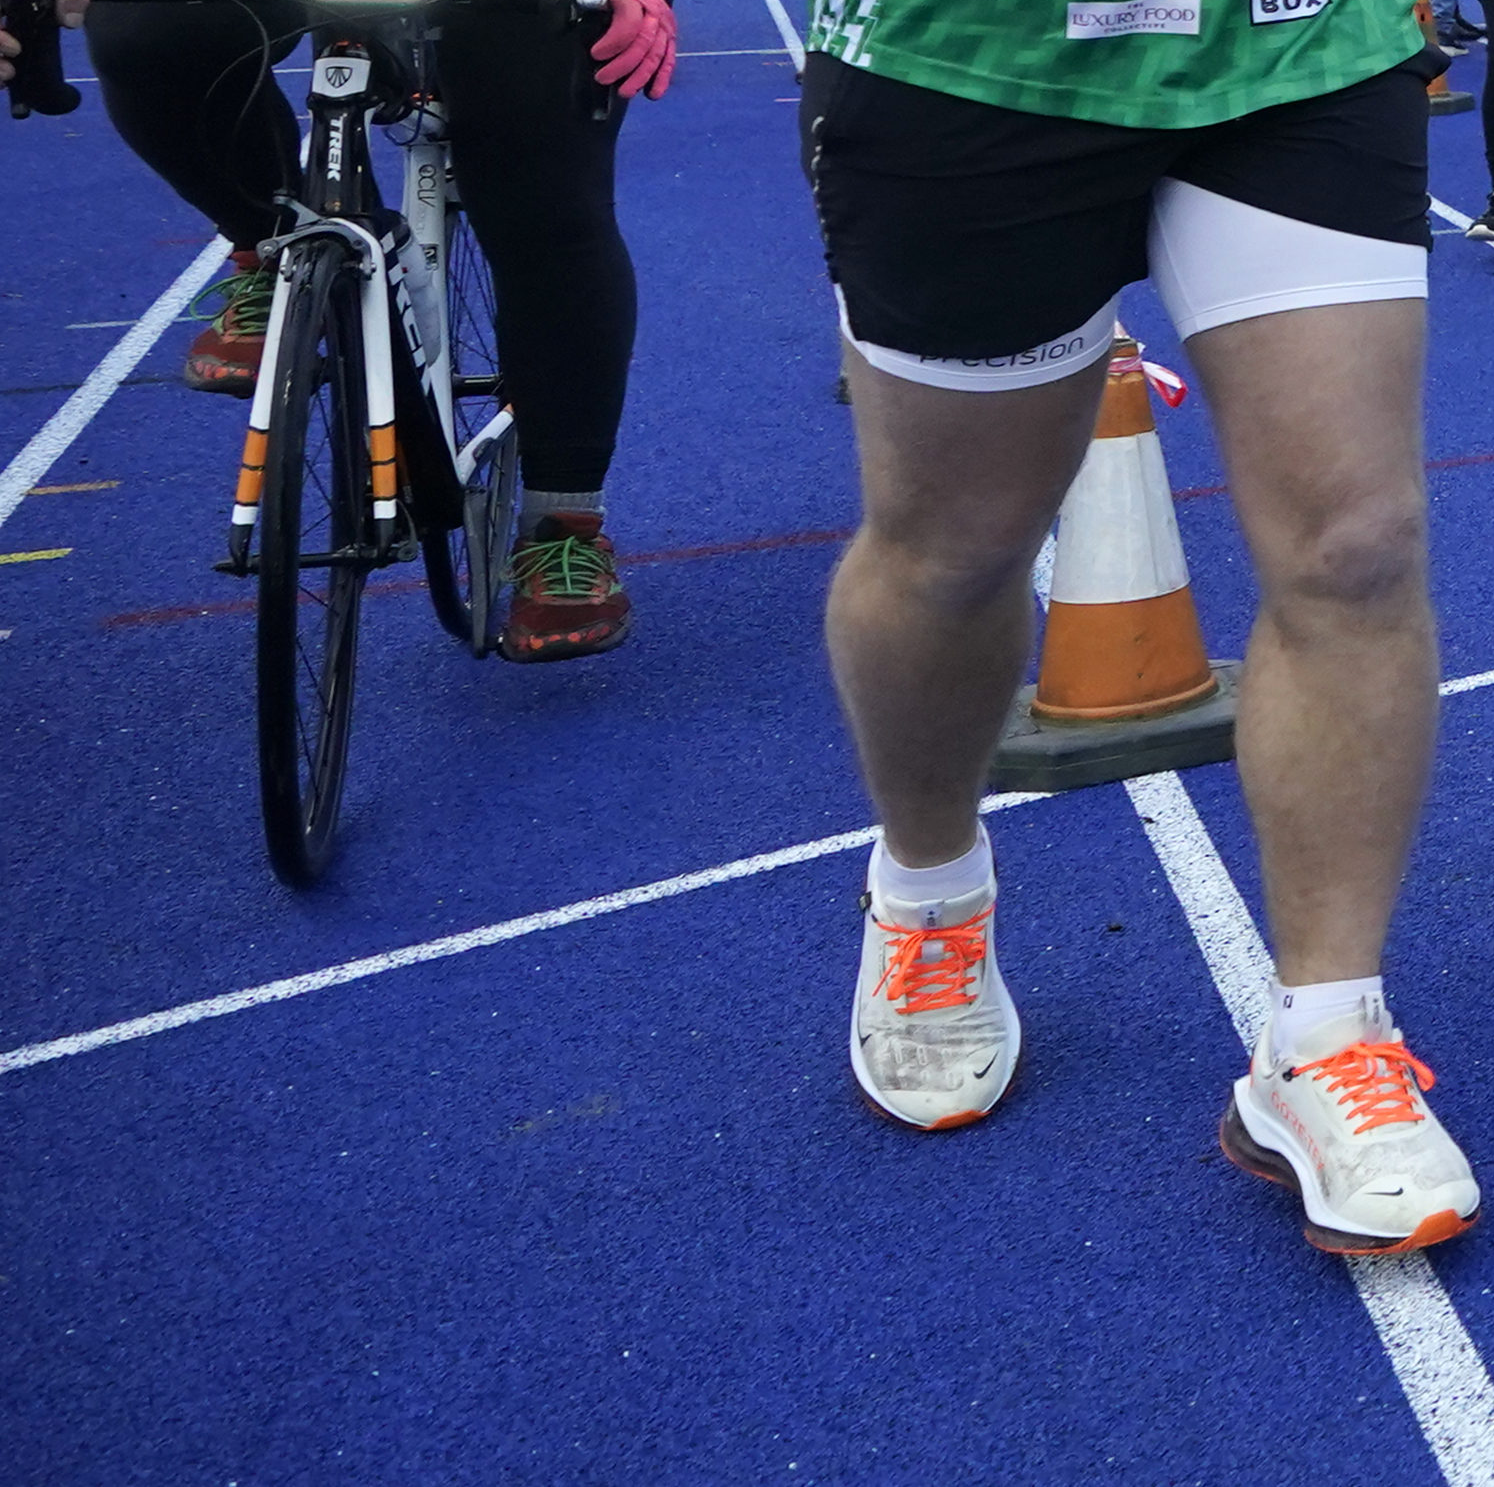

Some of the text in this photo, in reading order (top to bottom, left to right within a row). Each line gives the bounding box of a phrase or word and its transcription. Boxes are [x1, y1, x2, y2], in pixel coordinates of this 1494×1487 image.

[1072, 7, 1196, 27] LUXURY FOOD
[327, 114, 346, 181] TREK
[417, 163, 437, 209] OCLV
